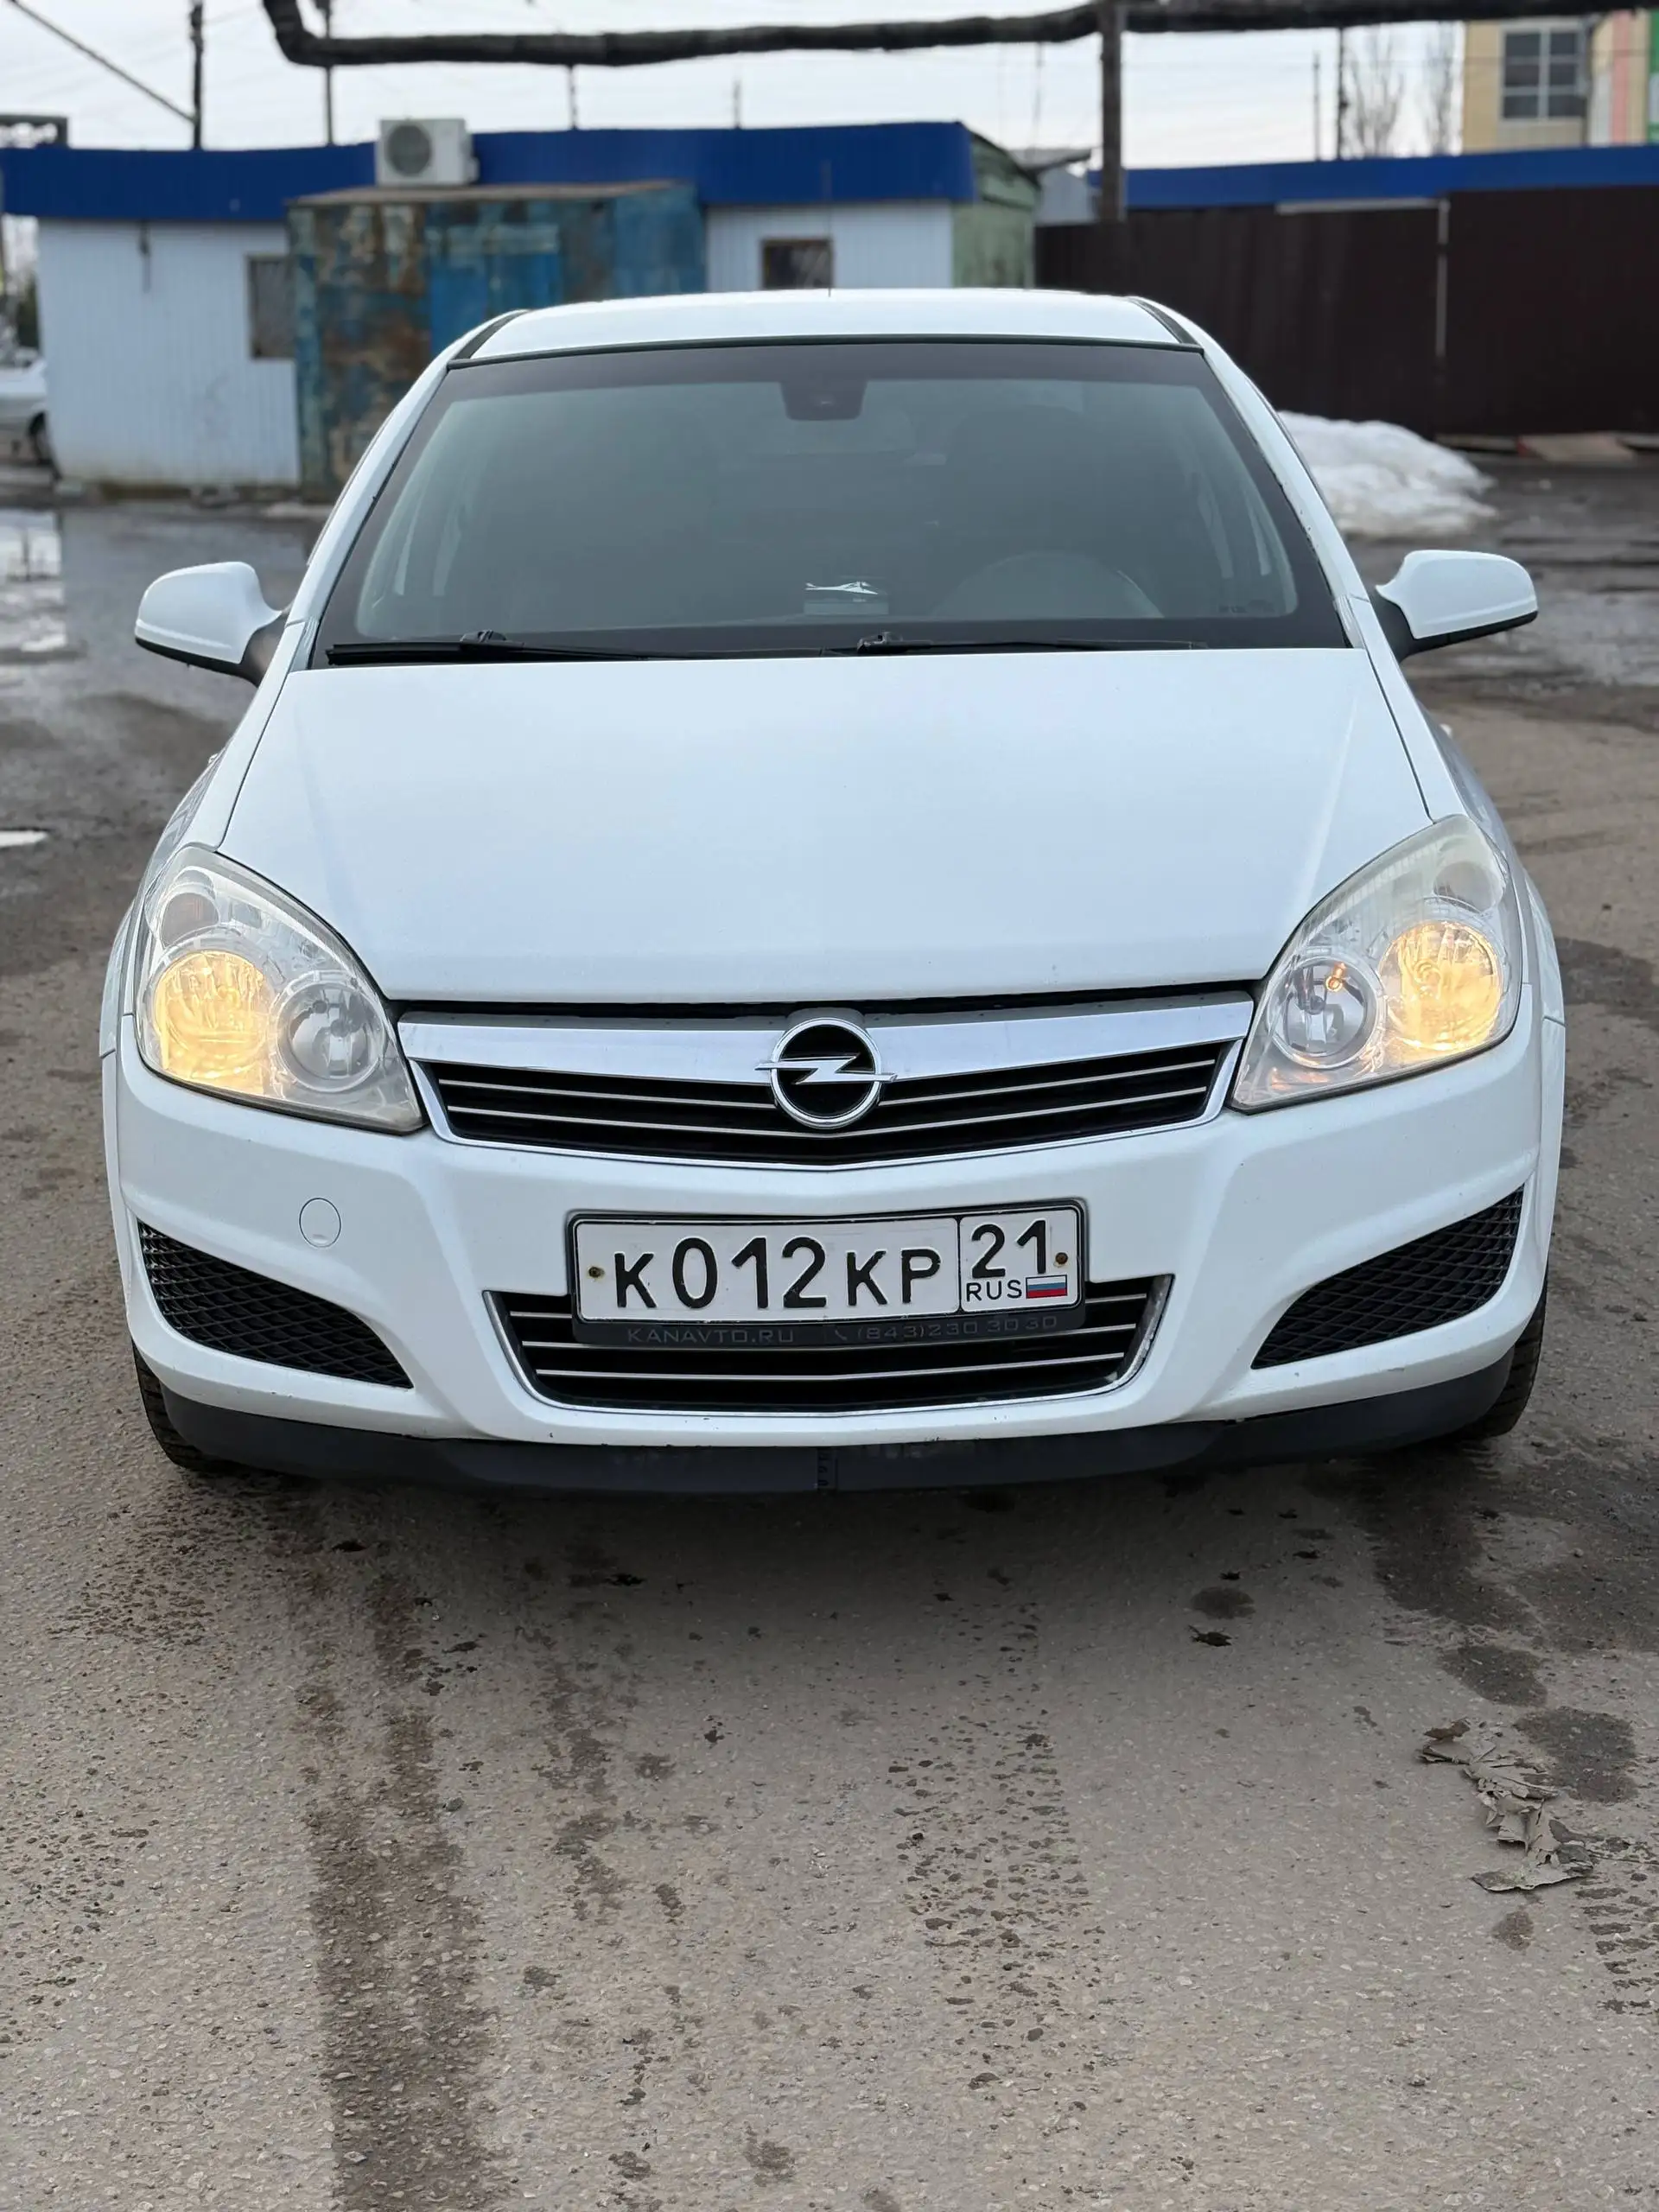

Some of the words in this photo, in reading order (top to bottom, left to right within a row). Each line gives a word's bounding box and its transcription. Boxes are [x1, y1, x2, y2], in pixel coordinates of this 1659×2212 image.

[971, 1220, 1046, 1279] 21
[966, 1280, 1022, 1302] RUS
[626, 1328, 794, 1344] KANAVTO.RU
